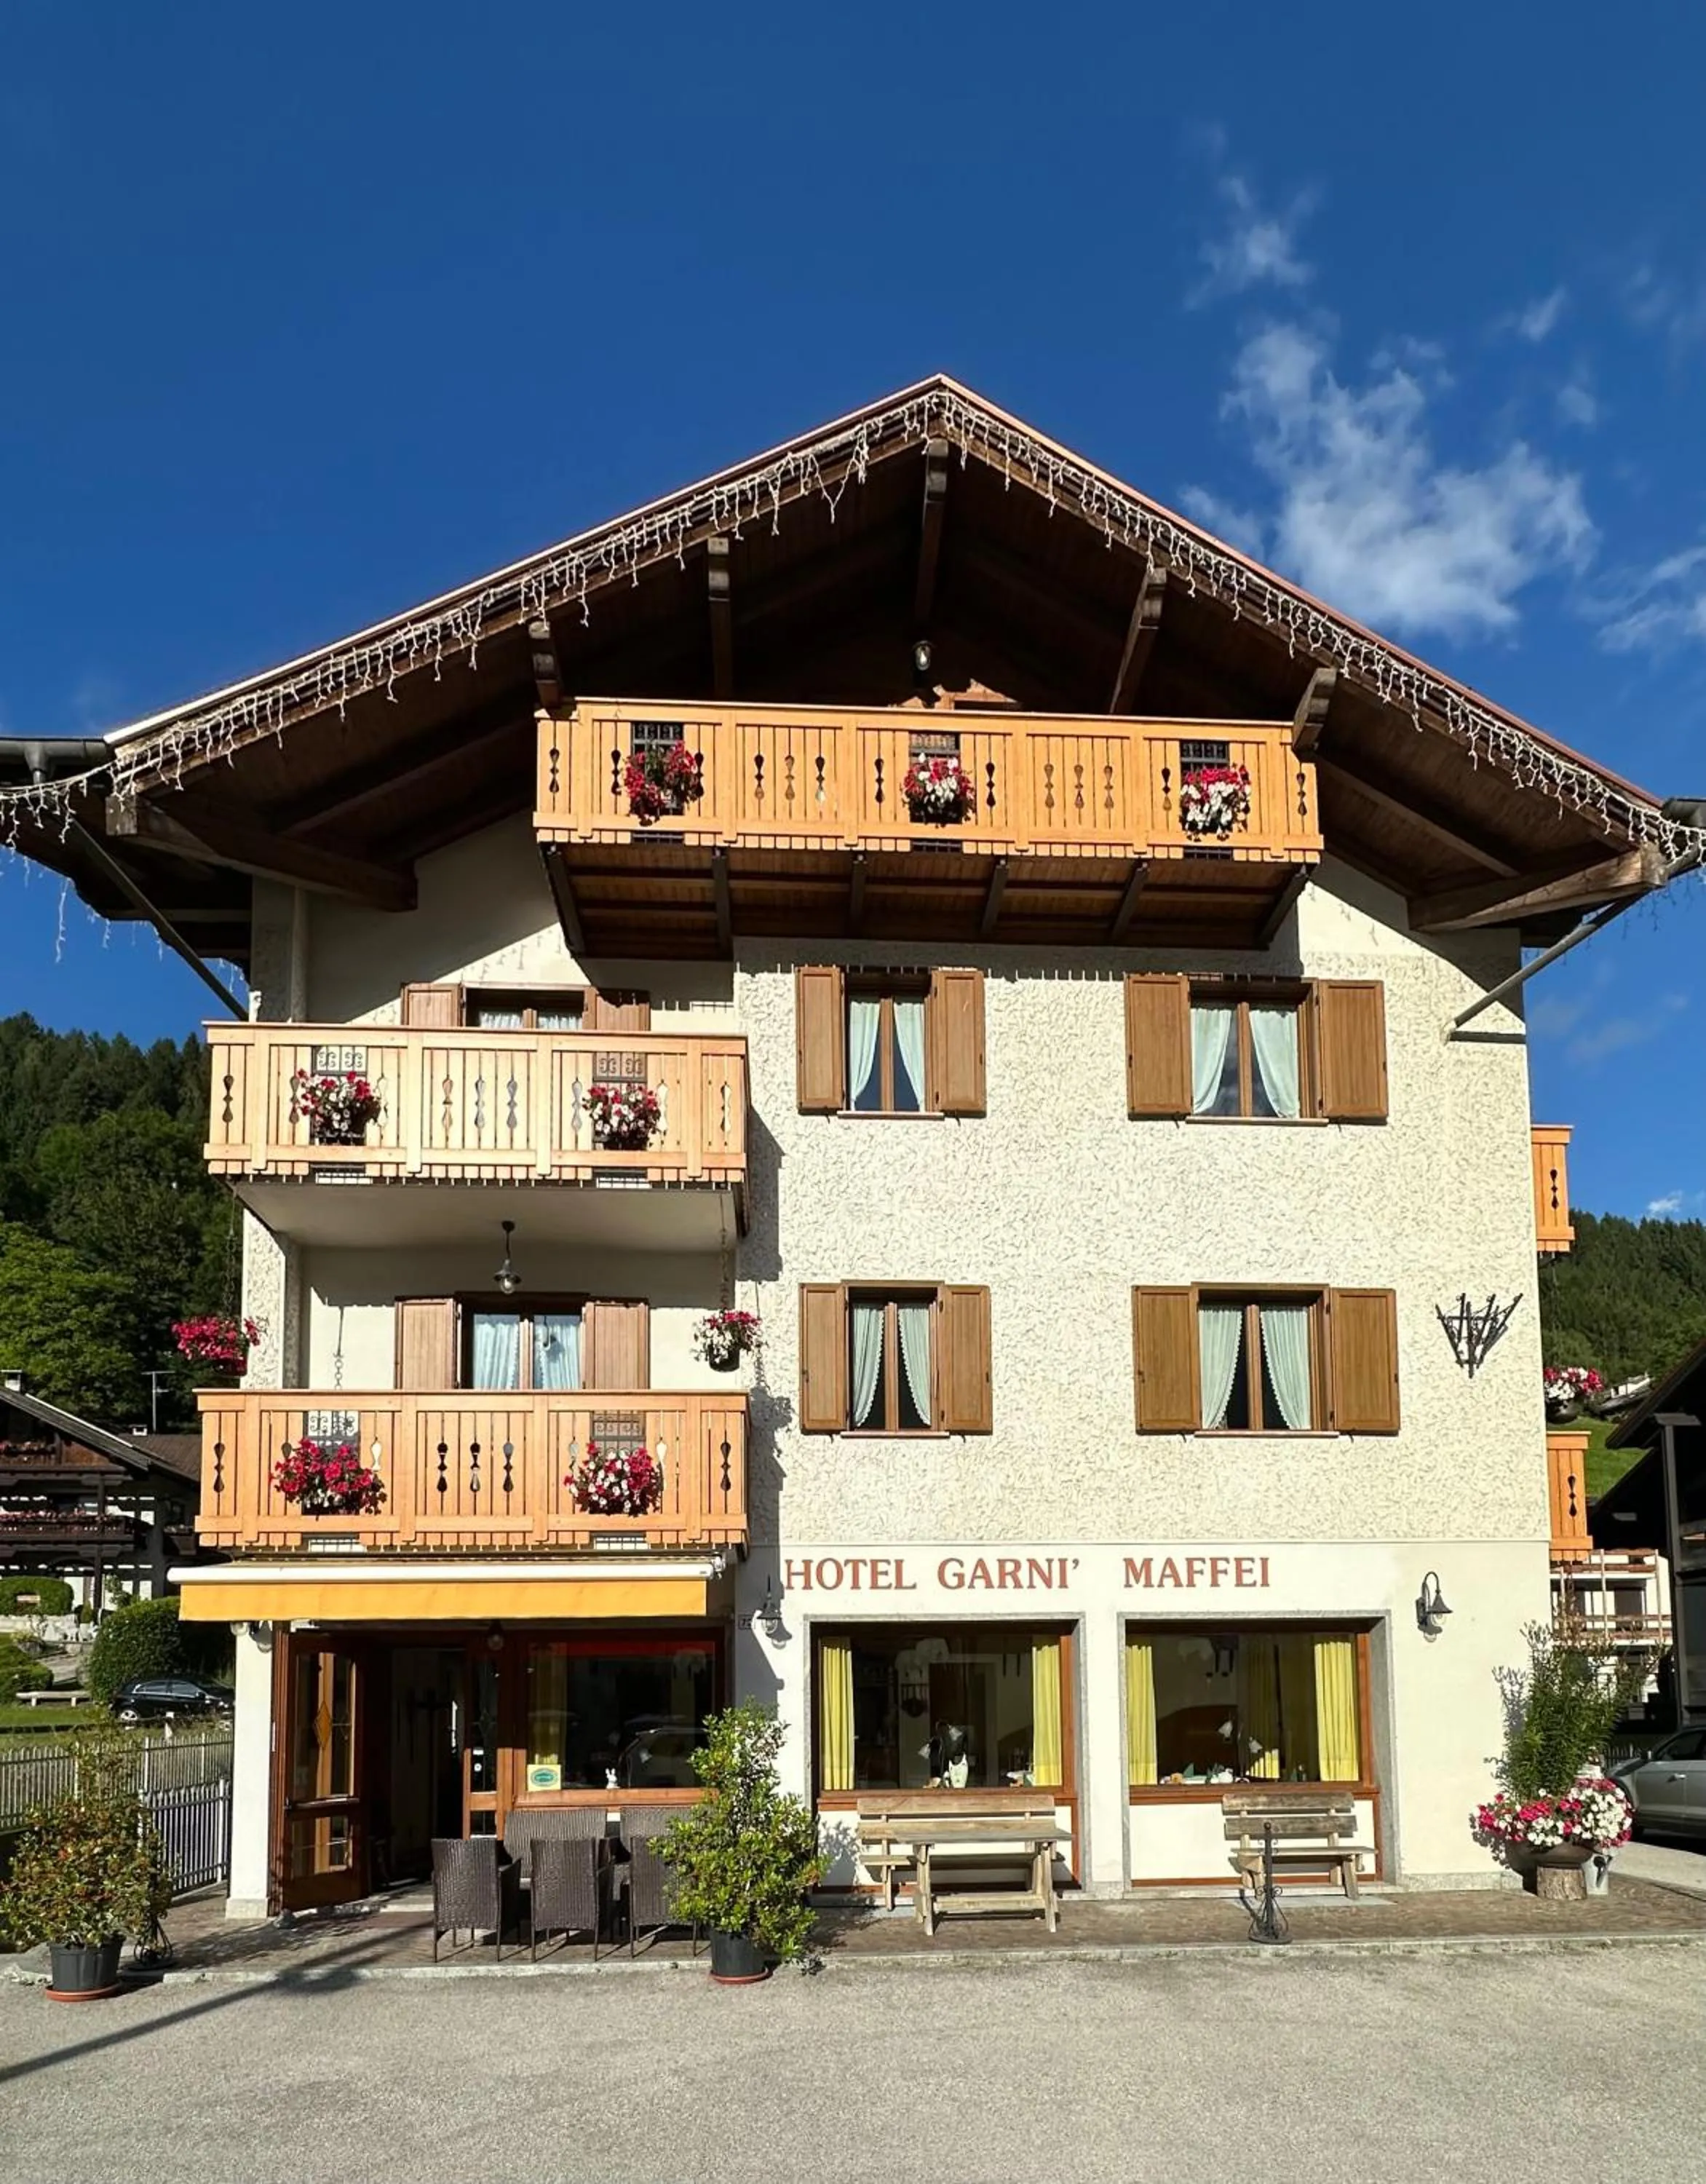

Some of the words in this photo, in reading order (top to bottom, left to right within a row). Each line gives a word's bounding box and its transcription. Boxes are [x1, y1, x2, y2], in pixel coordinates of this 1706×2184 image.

[785, 1557, 917, 1590] HOTEL
[937, 1557, 1080, 1590] GARNI'
[1123, 1556, 1269, 1588] MAFFEI
